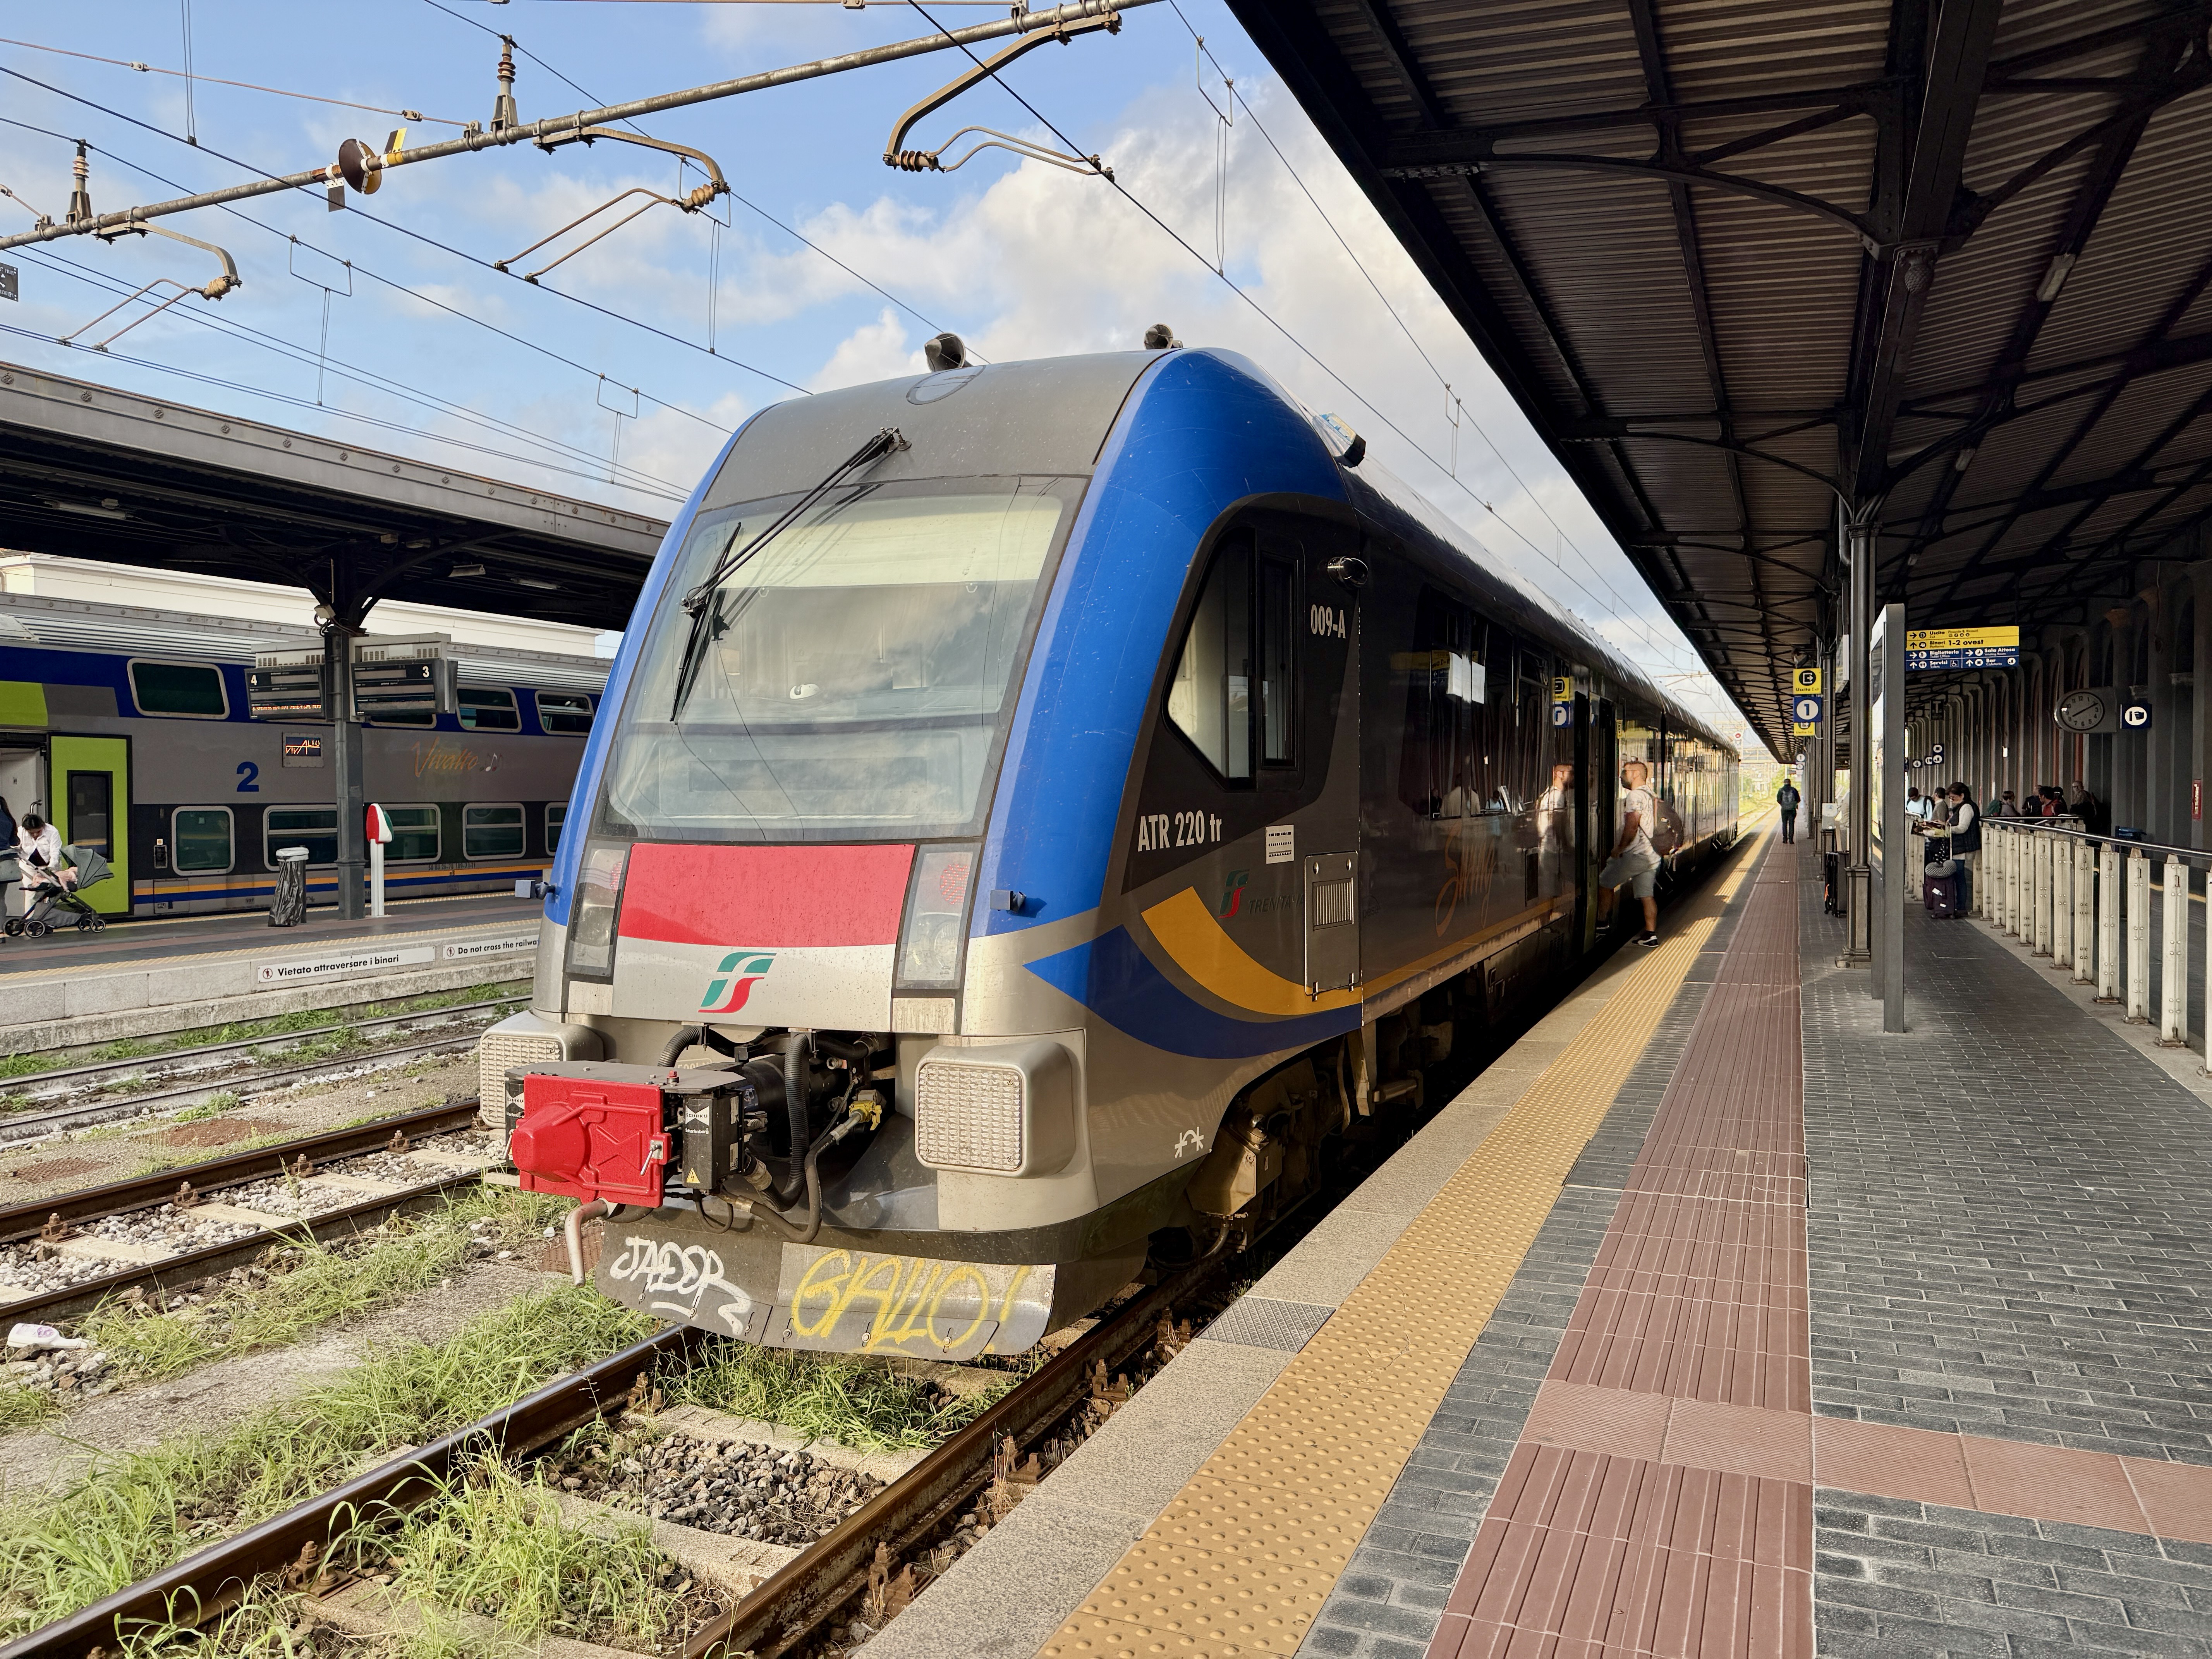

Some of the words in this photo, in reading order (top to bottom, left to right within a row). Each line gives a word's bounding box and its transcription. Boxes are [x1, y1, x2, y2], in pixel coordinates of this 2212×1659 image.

[1311, 604, 1346, 639] 009-A
[251, 675, 257, 685] 4
[422, 665, 429, 678] 3
[1804, 704, 1810, 716] 1
[410, 735, 480, 778] Vivalto
[236, 761, 259, 792] 2
[1137, 814, 1170, 852] ATR
[1175, 810, 1205, 847] 220
[1209, 814, 1222, 842] tr
[278, 965, 311, 976] Vietato
[314, 960, 368, 972] attraversare
[374, 955, 399, 964] binari
